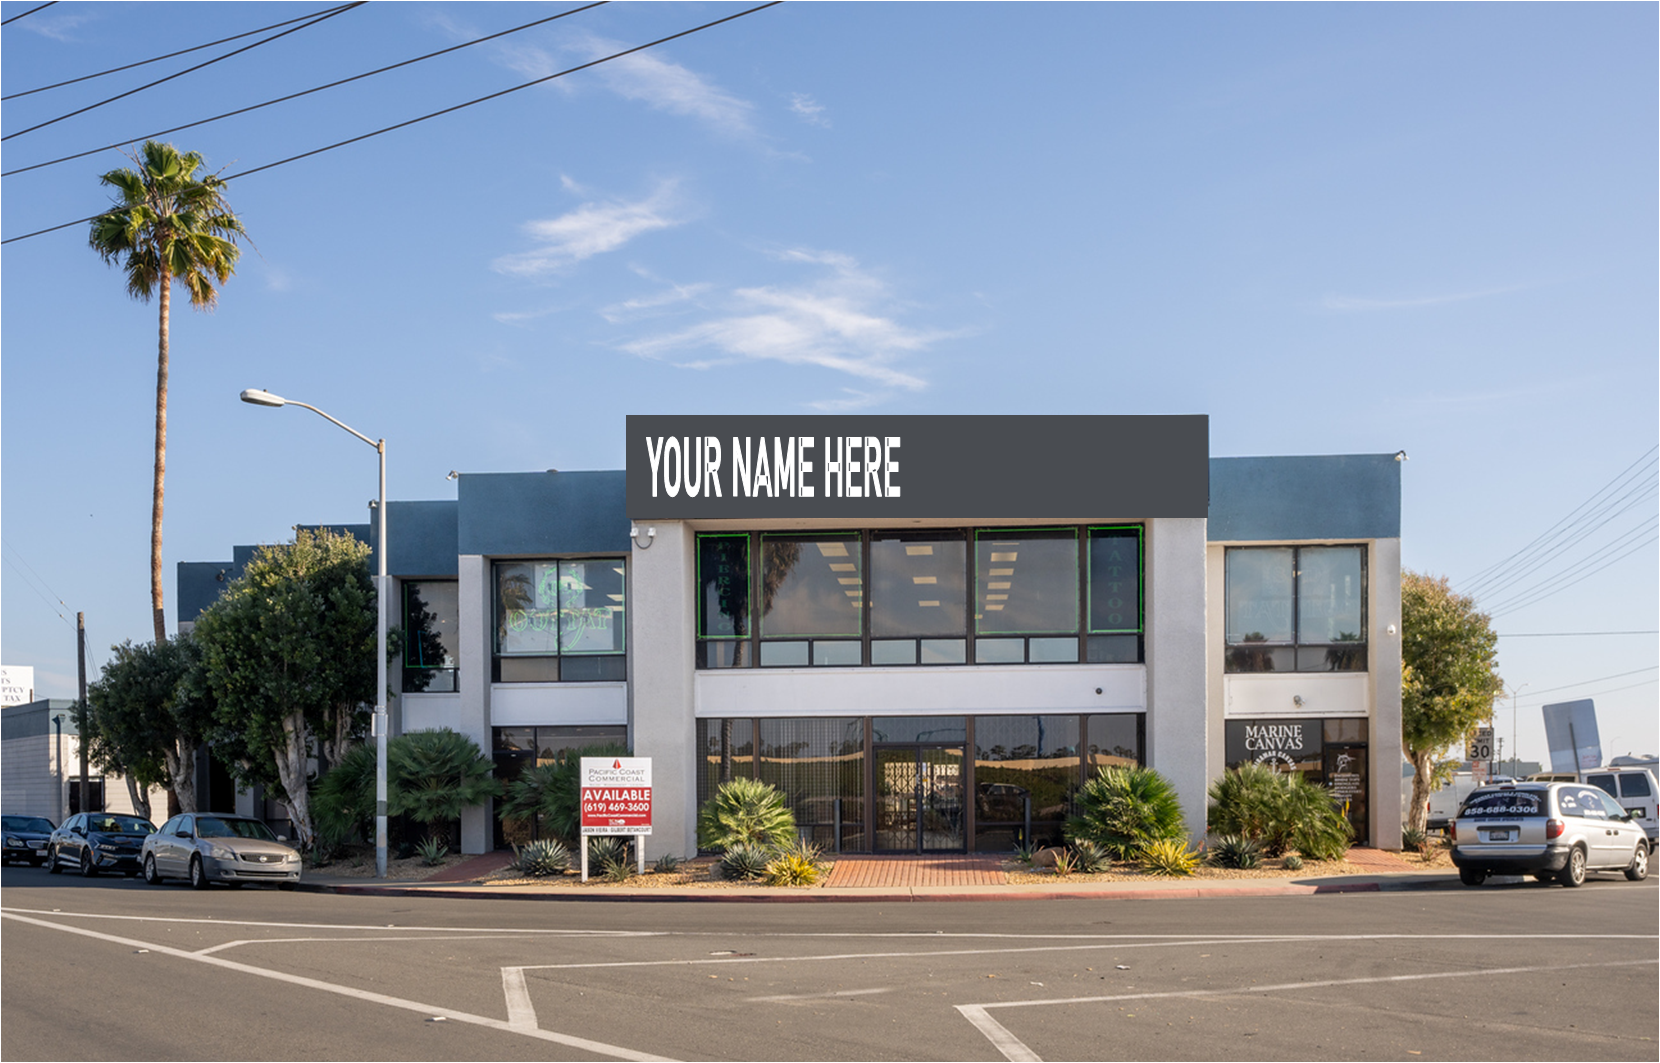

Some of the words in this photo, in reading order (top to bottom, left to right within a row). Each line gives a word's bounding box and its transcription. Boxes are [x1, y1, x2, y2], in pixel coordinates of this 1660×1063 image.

[1108, 534, 1123, 625] TATTOO
[717, 541, 731, 632] PIERCING
[1245, 725, 1302, 738] MARINE
[1245, 737, 1303, 750] CANVAS
[1470, 745, 1490, 758] 30
[583, 789, 650, 801] AVAILABLE
[584, 803, 606, 813] (619)
[608, 803, 649, 812] 469-3600
[1464, 806, 1538, 816] 858-688-0306
